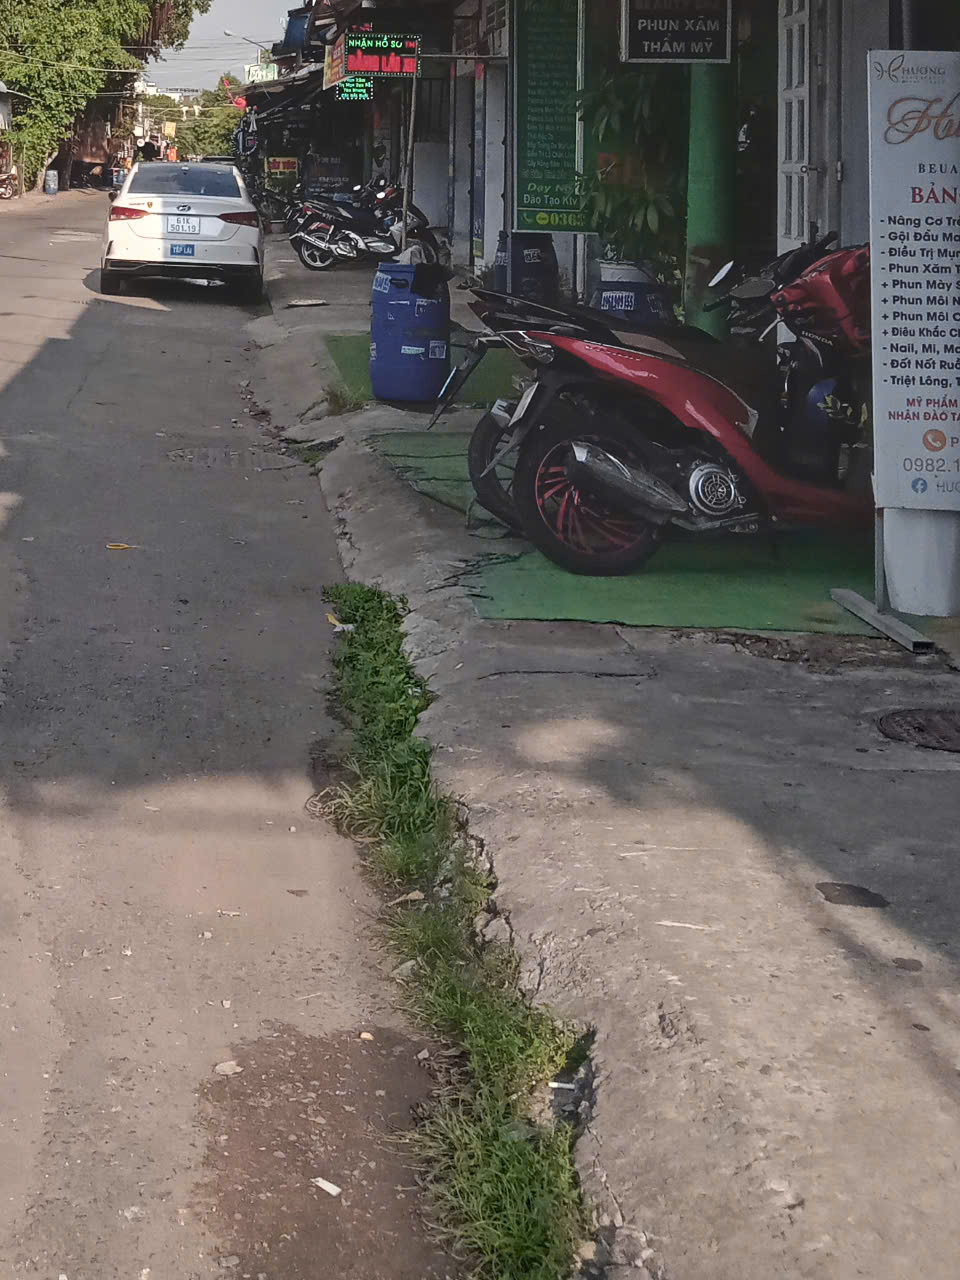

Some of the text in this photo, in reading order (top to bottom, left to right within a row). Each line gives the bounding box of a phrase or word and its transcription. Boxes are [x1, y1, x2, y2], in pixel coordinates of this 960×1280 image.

[637, 19, 679, 31] PHUN
[348, 37, 373, 50] NHẬN
[642, 33, 713, 53] THẨM MỸ
[918, 163, 960, 174] BEUA
[910, 181, 960, 204] BẢN
[887, 215, 921, 228] Nâng
[925, 216, 943, 226] Cơ
[888, 231, 910, 244] Gội
[920, 248, 934, 260] Trị
[888, 263, 919, 273] Phun
[922, 263, 951, 273] Xăm
[892, 279, 922, 289] Phun
[892, 295, 922, 305] Phun
[926, 295, 949, 306] Môi
[892, 311, 923, 321] Phun
[926, 311, 949, 321] Môi
[918, 325, 947, 337] Khắc
[801, 330, 833, 346] HONDA
[890, 343, 918, 355] Nail,
[922, 343, 940, 355] Mi,
[890, 357, 911, 369] Đốt
[915, 357, 936, 369] Nốt
[890, 375, 916, 388] Triệt
[919, 375, 952, 388] Lông,
[906, 393, 958, 408] MỸ PHẨM
[888, 409, 920, 422] NHẬN
